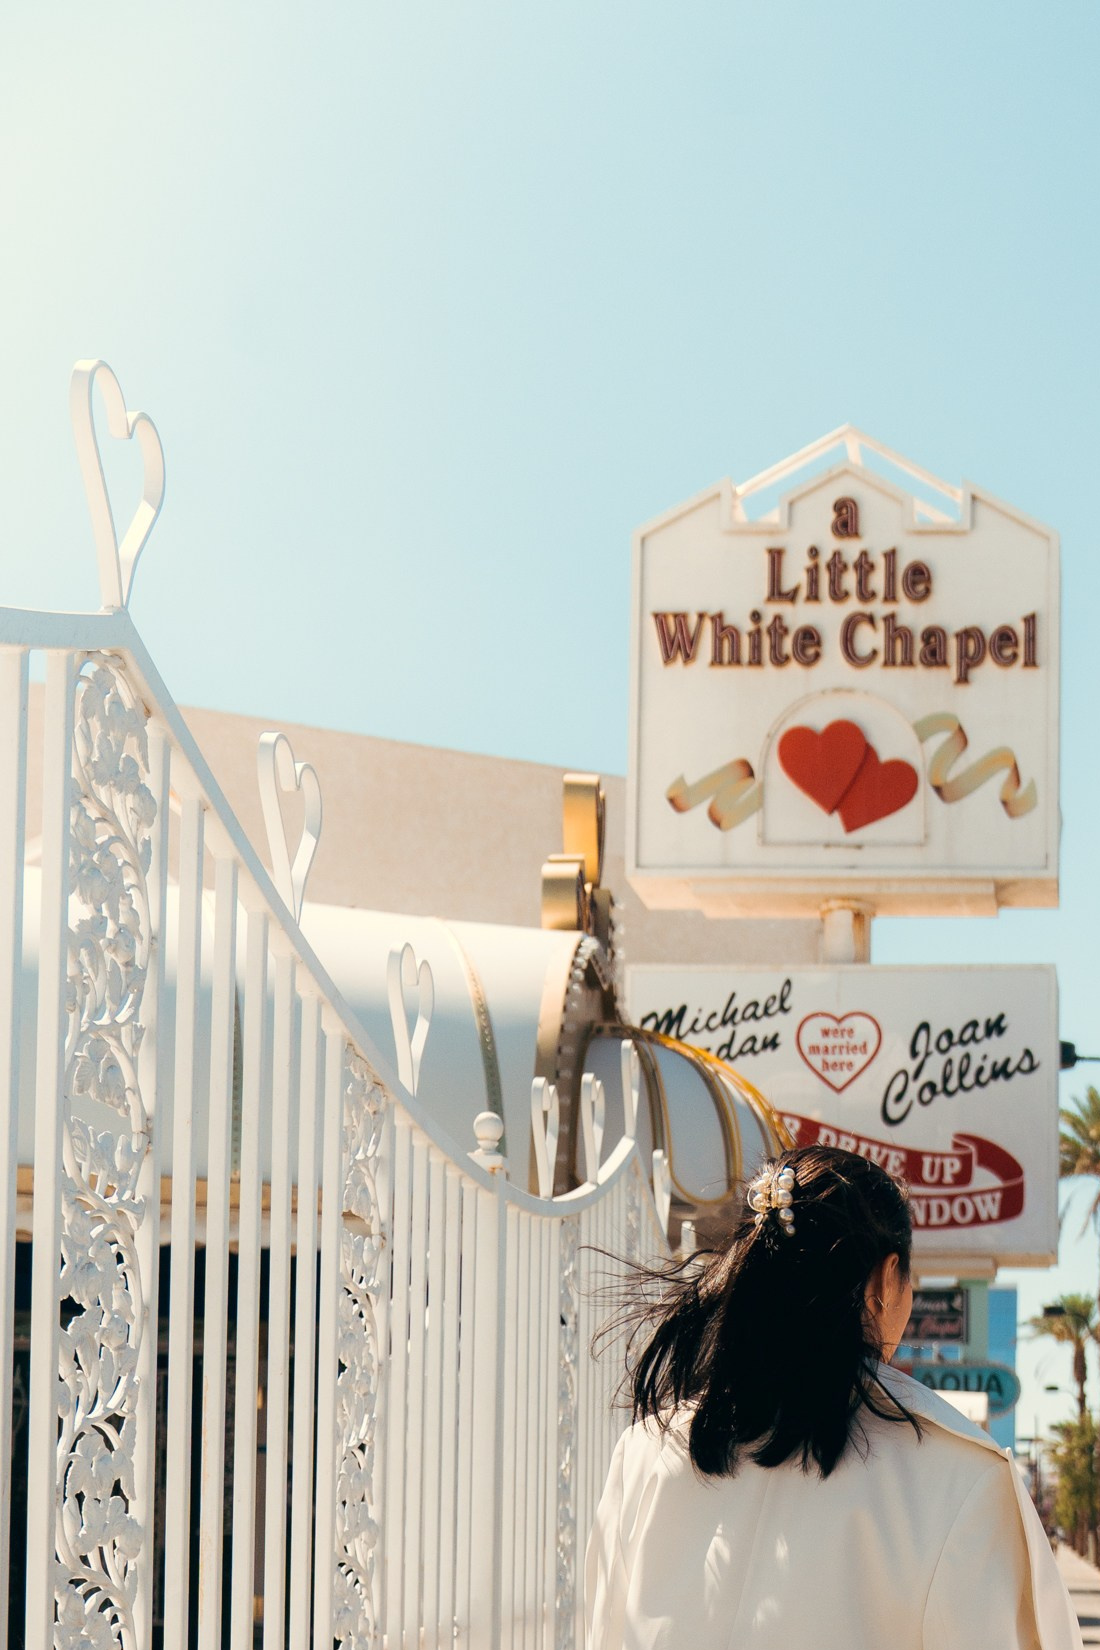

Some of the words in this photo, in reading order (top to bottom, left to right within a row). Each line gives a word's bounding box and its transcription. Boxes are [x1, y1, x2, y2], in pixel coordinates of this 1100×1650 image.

[831, 496, 861, 540] a
[764, 545, 932, 604] Little
[653, 609, 823, 668] White
[839, 610, 1039, 685] Chapel
[640, 978, 792, 1041] Michael
[704, 1029, 781, 1062] dan
[808, 1041, 868, 1056] married
[821, 1027, 854, 1039] were
[909, 1012, 1007, 1082] Joan
[821, 1058, 854, 1072] here
[881, 1048, 1040, 1128] Collins
[920, 1155, 963, 1185] UP
[909, 1191, 1003, 1227] NDOW
